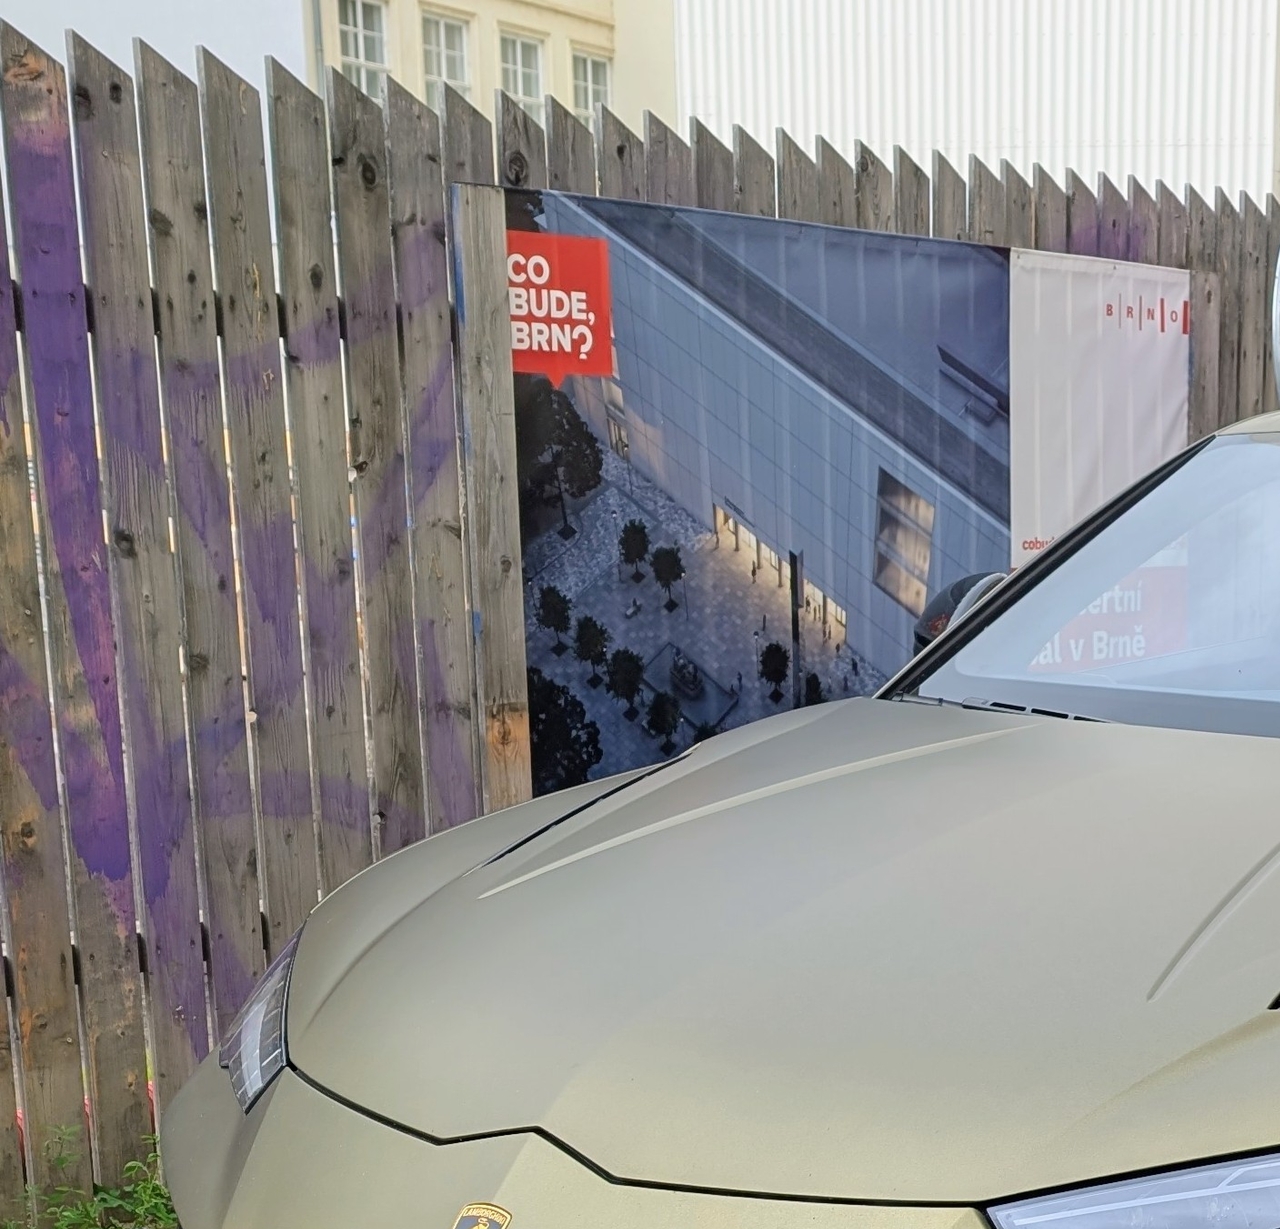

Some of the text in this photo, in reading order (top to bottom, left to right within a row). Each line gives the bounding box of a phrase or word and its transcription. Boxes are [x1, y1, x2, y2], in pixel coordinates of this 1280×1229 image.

[507, 253, 550, 285] CO
[508, 286, 595, 326] BUDE,
[1069, 638, 1084, 662] v
[1092, 624, 1146, 660] Brně
